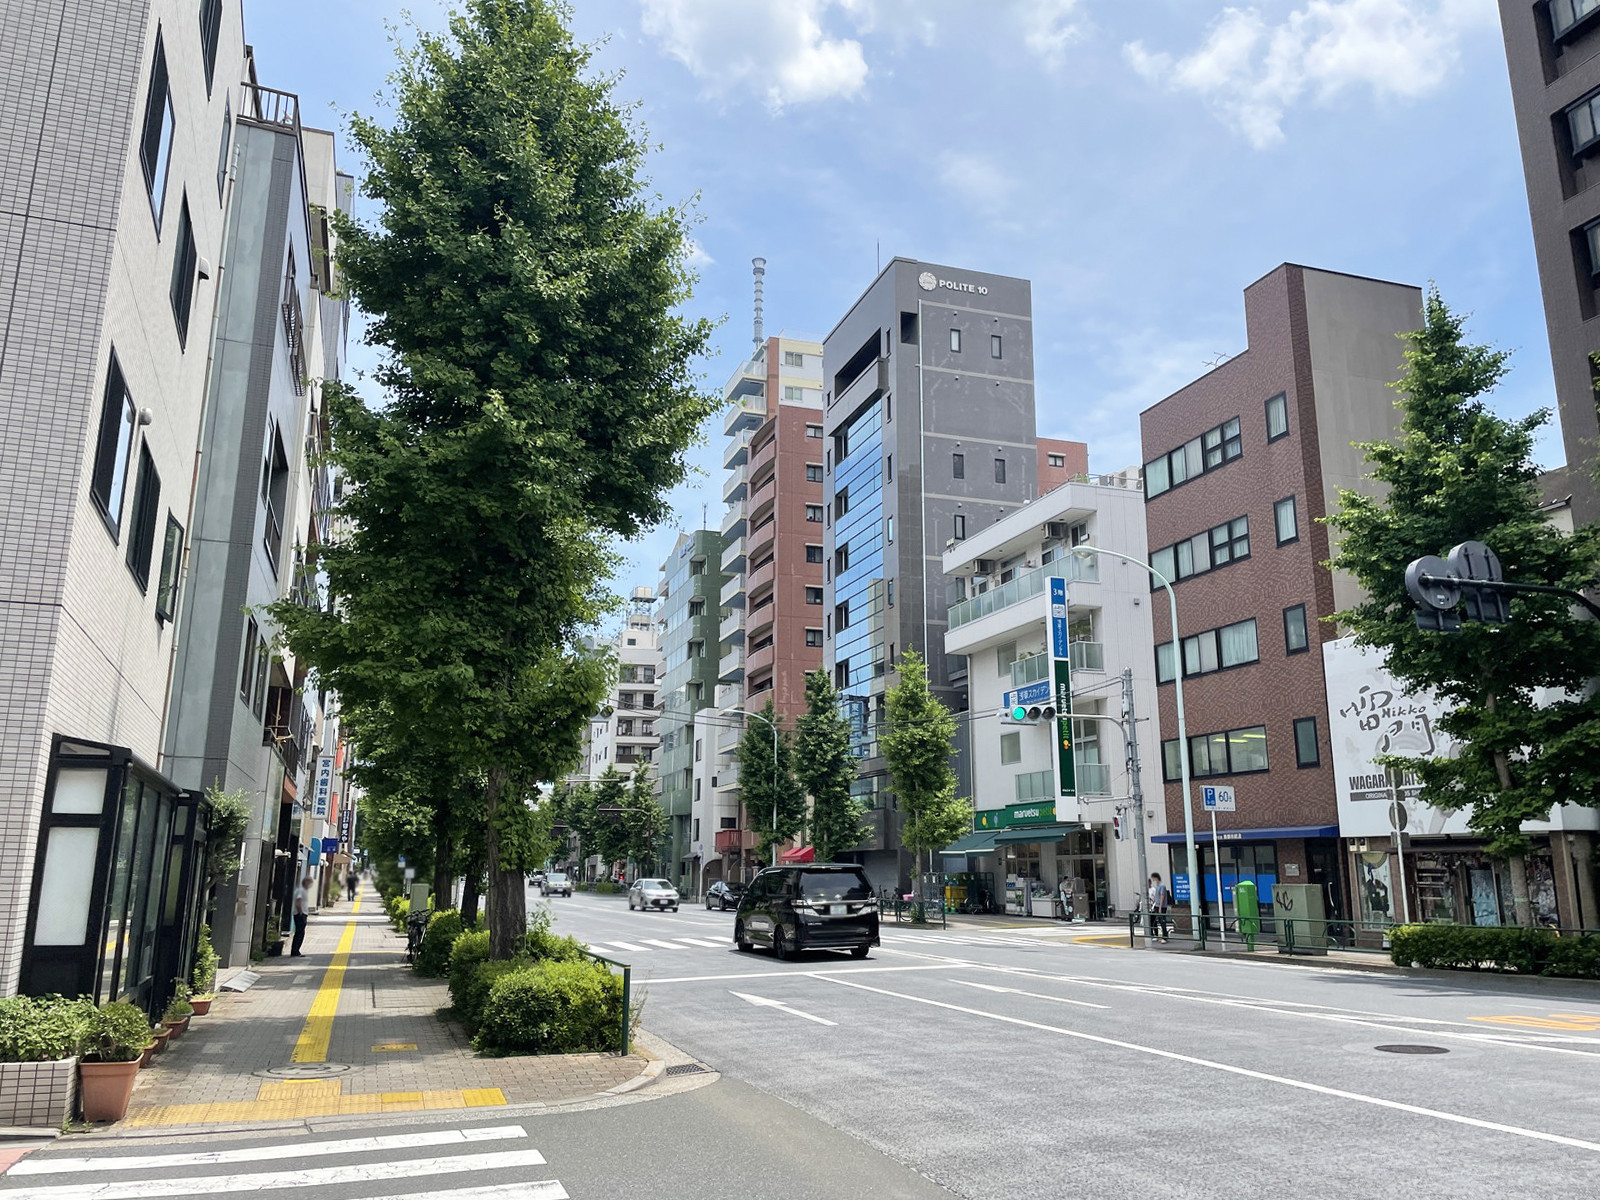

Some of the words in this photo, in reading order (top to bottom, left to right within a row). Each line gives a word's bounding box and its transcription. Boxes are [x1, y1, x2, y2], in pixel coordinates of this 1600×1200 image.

[939, 280, 975, 293] POLITE
[977, 286, 988, 295] 10
[1382, 705, 1426, 718] Nikko
[316, 759, 331, 815] 宮内歯科医院
